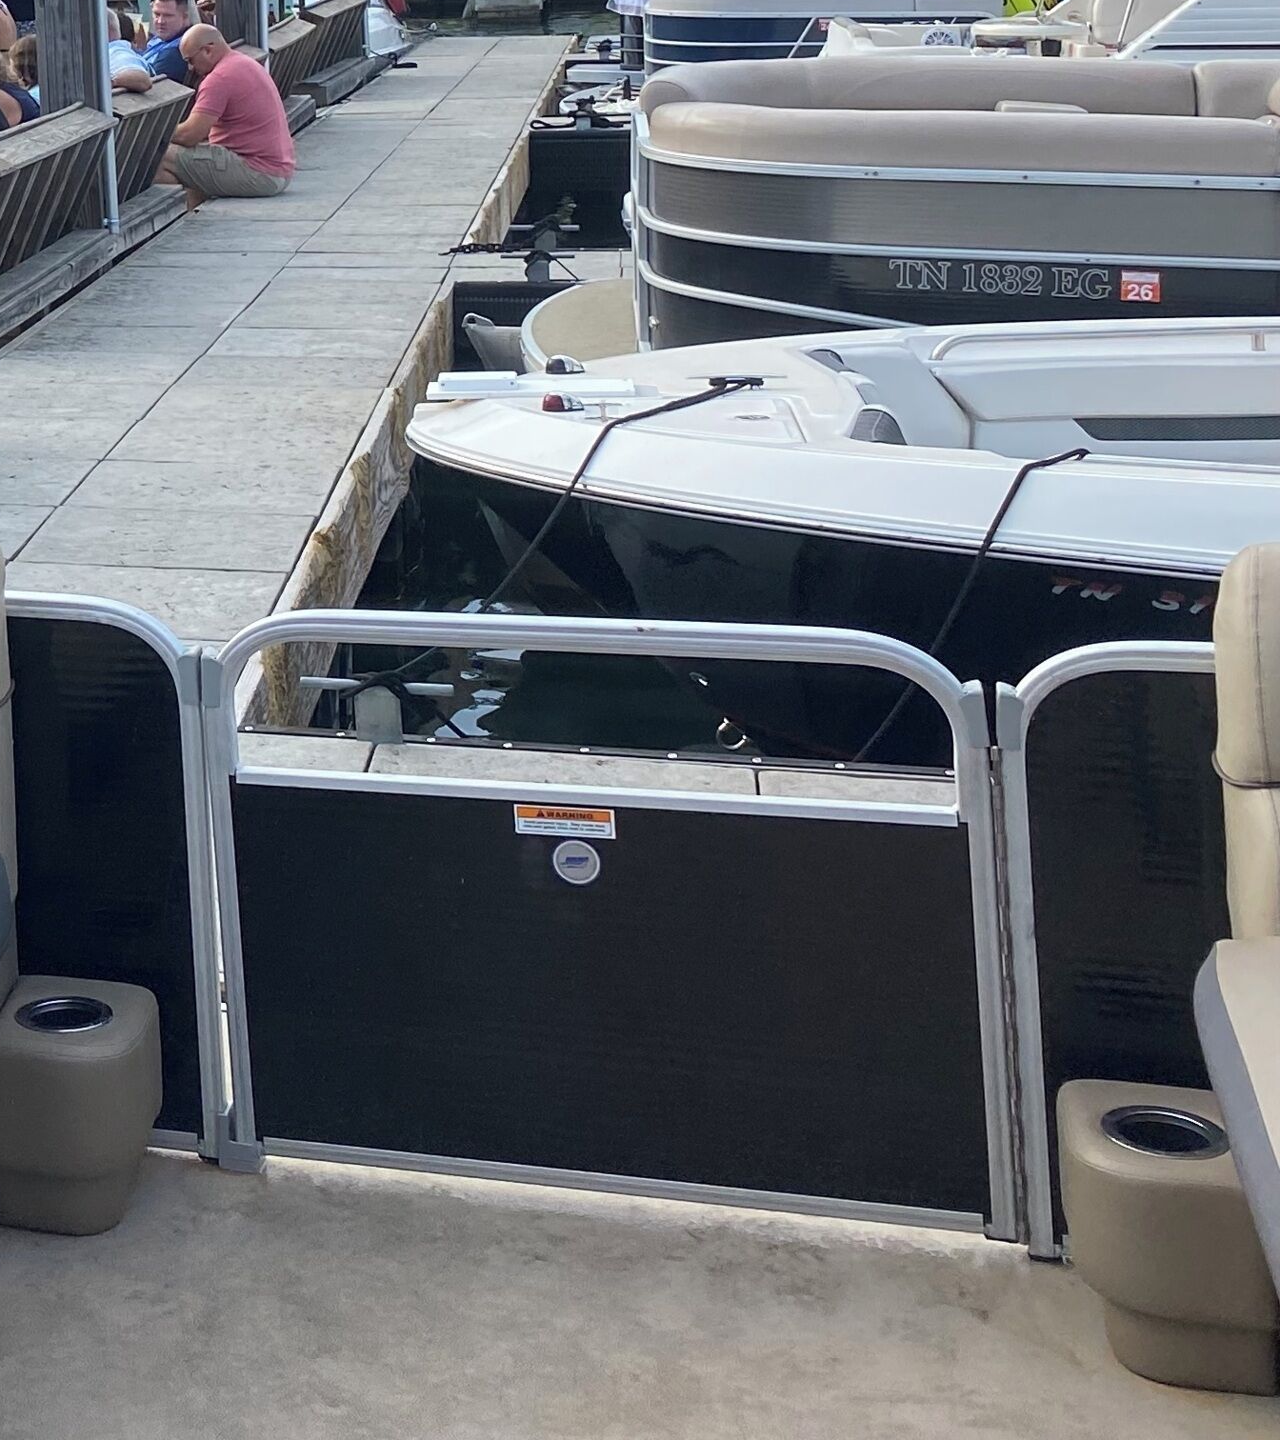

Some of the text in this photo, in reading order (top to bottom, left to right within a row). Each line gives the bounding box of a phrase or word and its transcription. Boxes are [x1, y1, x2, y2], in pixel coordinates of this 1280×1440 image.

[889, 259, 1112, 300] TN 1832 EG
[1127, 283, 1154, 301] 26
[546, 811, 593, 820] WARNING
